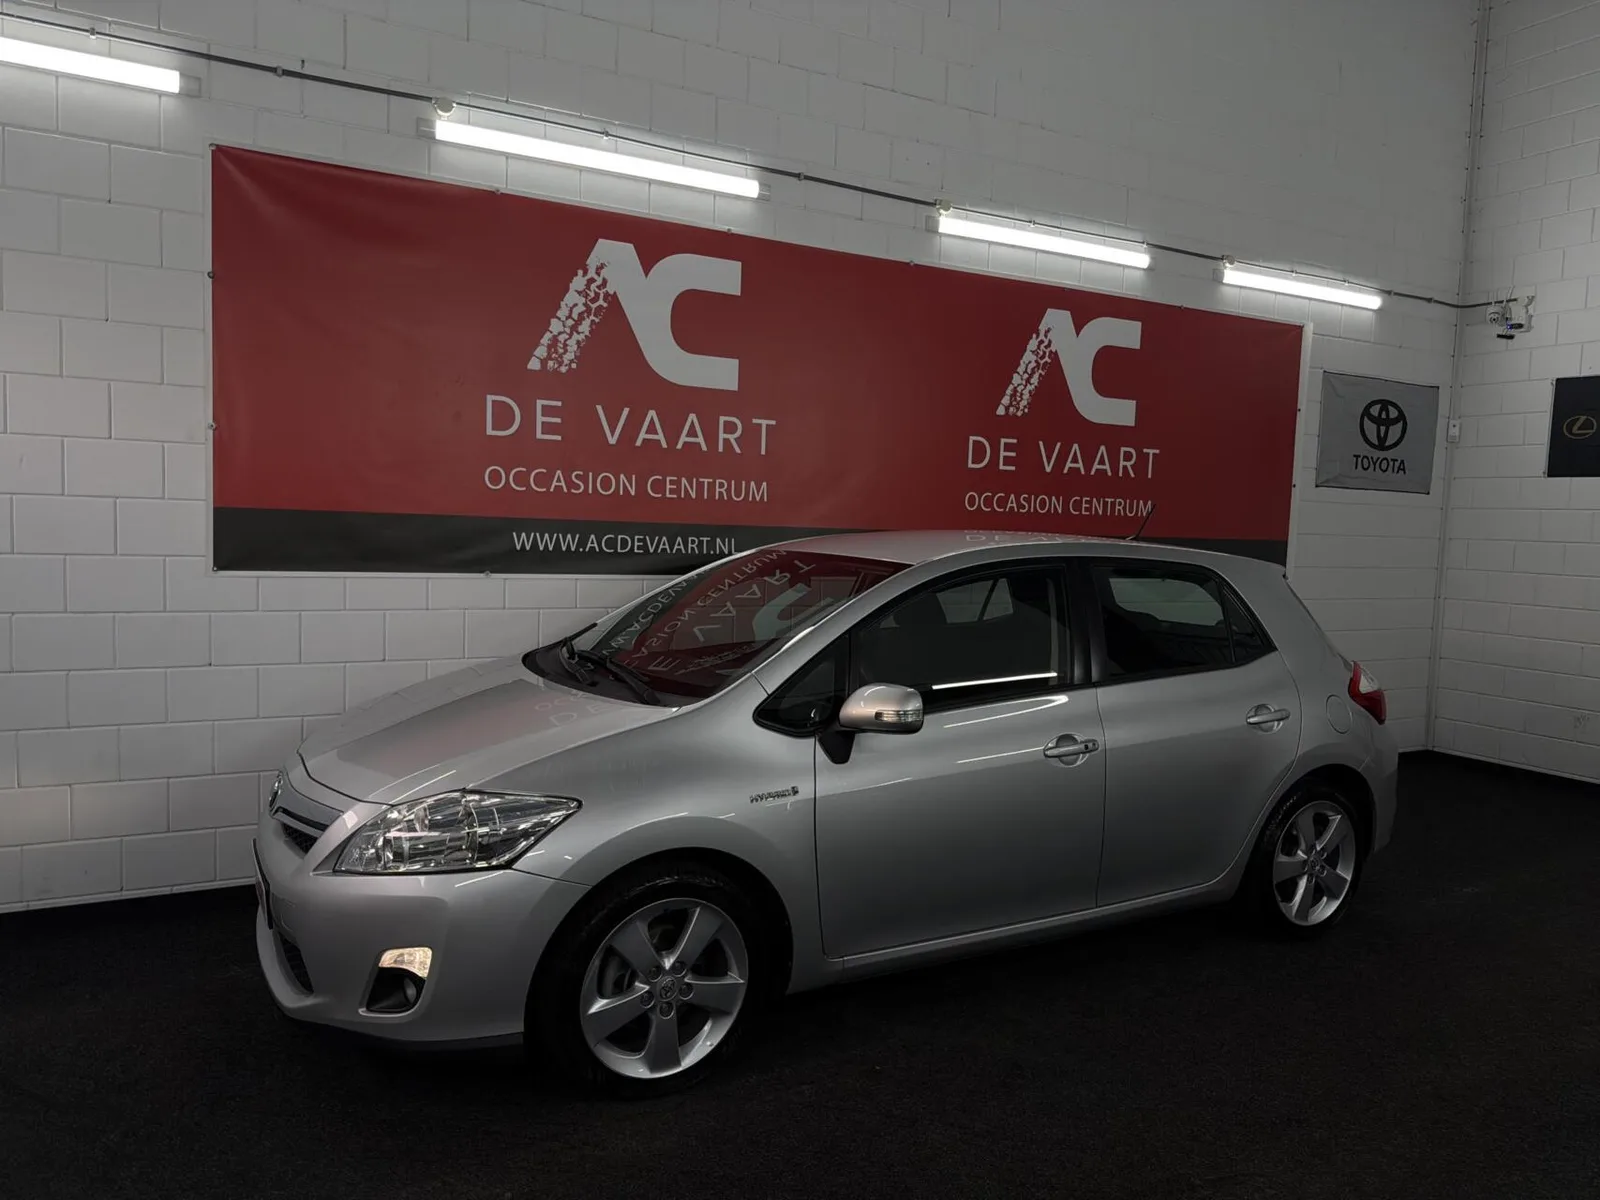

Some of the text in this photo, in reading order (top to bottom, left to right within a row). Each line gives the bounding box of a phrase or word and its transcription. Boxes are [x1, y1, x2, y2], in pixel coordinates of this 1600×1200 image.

[527, 238, 742, 391] AC
[996, 308, 1142, 426] AC
[485, 394, 777, 455] DE VAART
[967, 435, 1160, 479] DE VAART
[1353, 454, 1407, 475] TOYOTA
[484, 465, 768, 502] OCCASION CENTRUM
[965, 491, 1152, 517] OCCASION CENTRUM
[512, 531, 738, 554] WWW.ACDEVAART.NL
